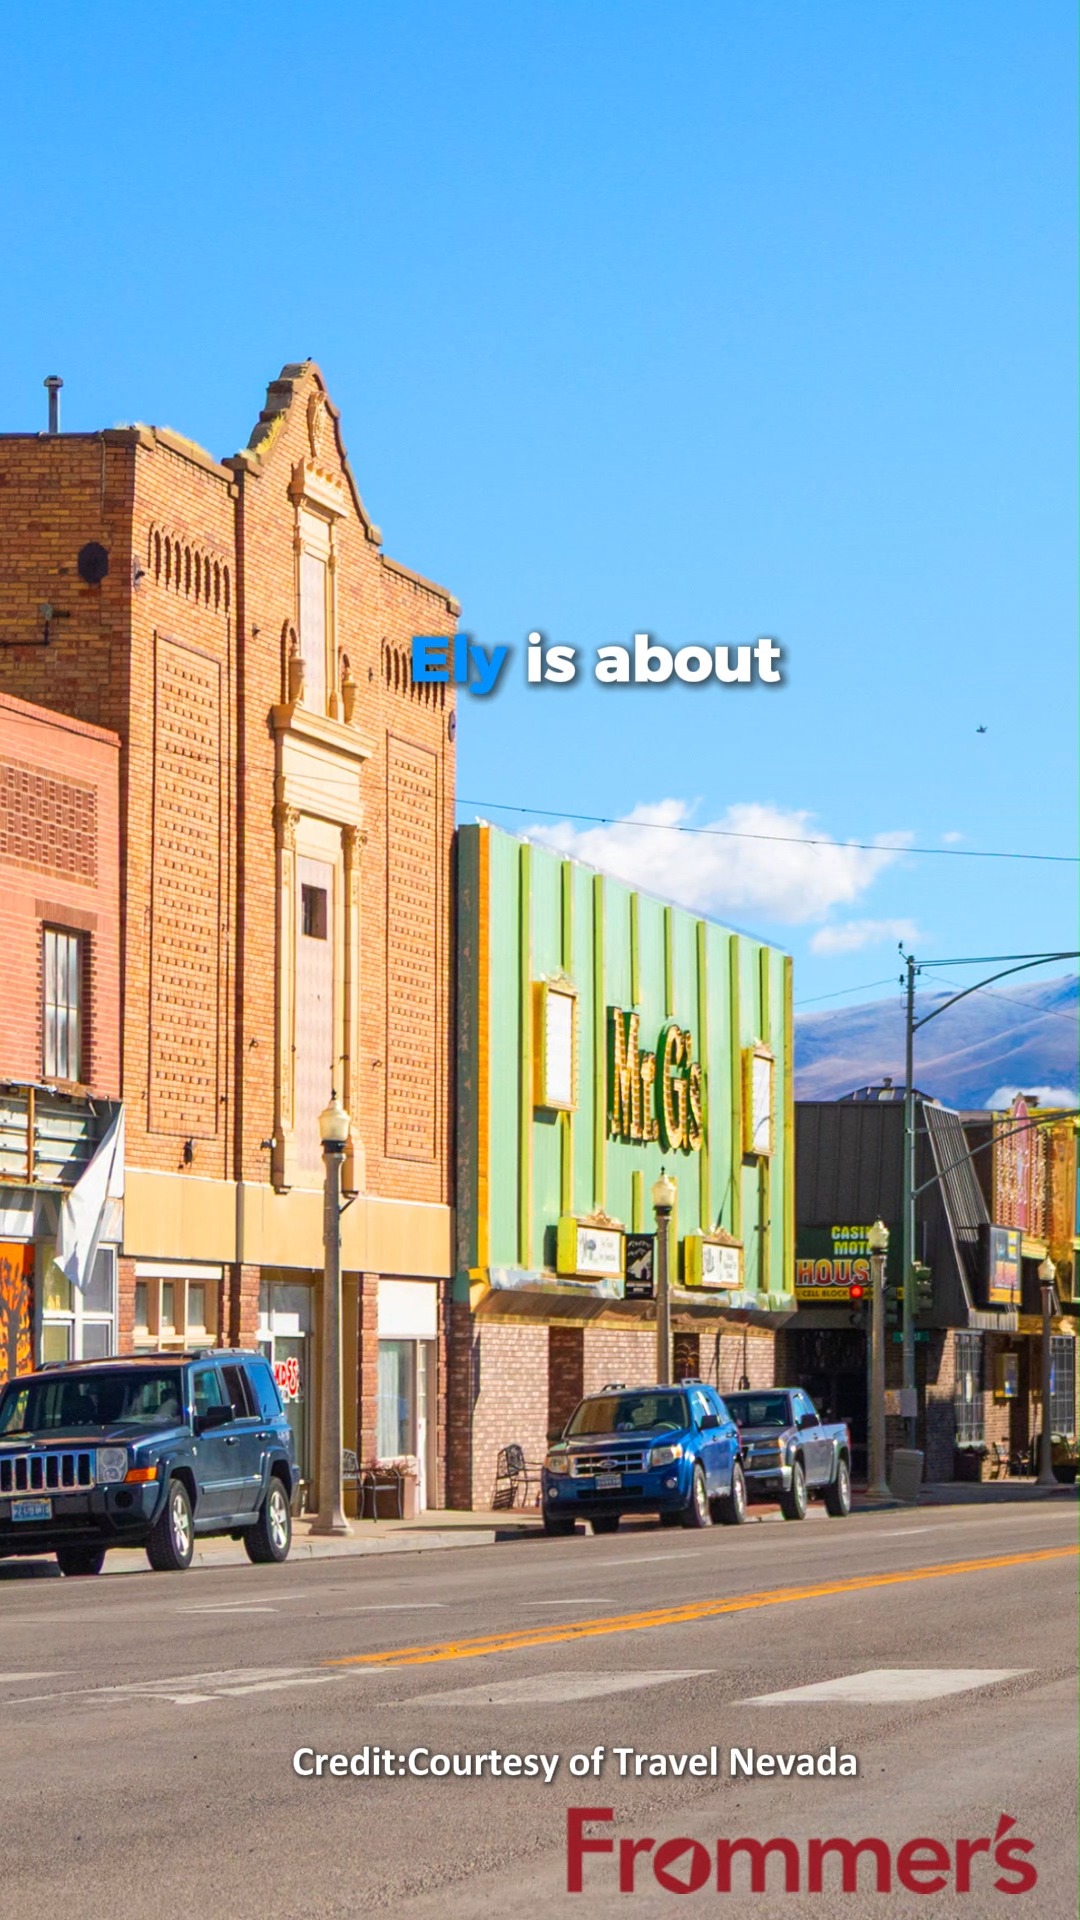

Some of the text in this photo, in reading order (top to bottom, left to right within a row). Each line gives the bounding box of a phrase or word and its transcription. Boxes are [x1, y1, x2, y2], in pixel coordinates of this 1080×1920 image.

[657, 1023, 704, 1153] G's
[833, 1241, 873, 1255] MOTE
[796, 1258, 886, 1286] HOUS
[801, 1289, 847, 1298] CELL BLOCK
